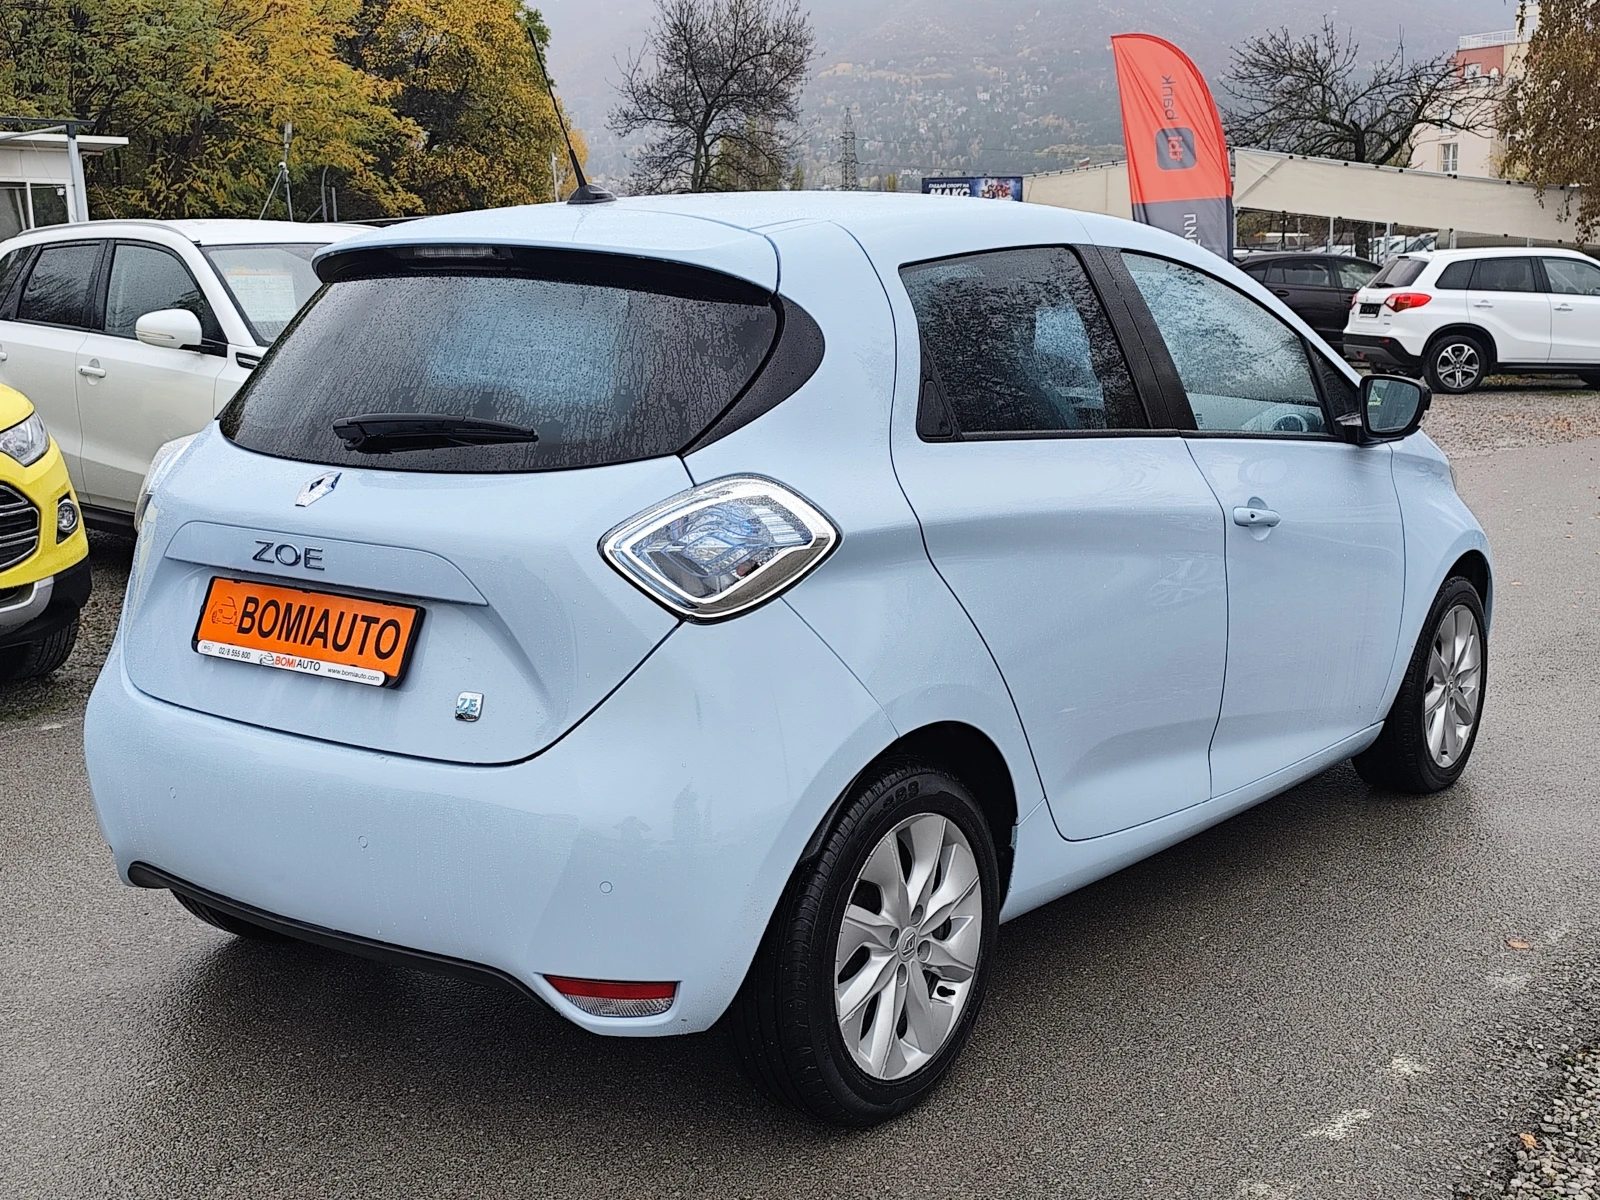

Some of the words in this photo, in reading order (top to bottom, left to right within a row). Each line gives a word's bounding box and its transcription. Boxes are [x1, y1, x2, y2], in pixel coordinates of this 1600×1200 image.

[930, 188, 971, 198] МАКС
[252, 540, 325, 571] ZOE
[237, 596, 401, 660] BOMIAUTO
[241, 650, 251, 660] 800
[327, 668, 380, 682] www.bomiauto.com
